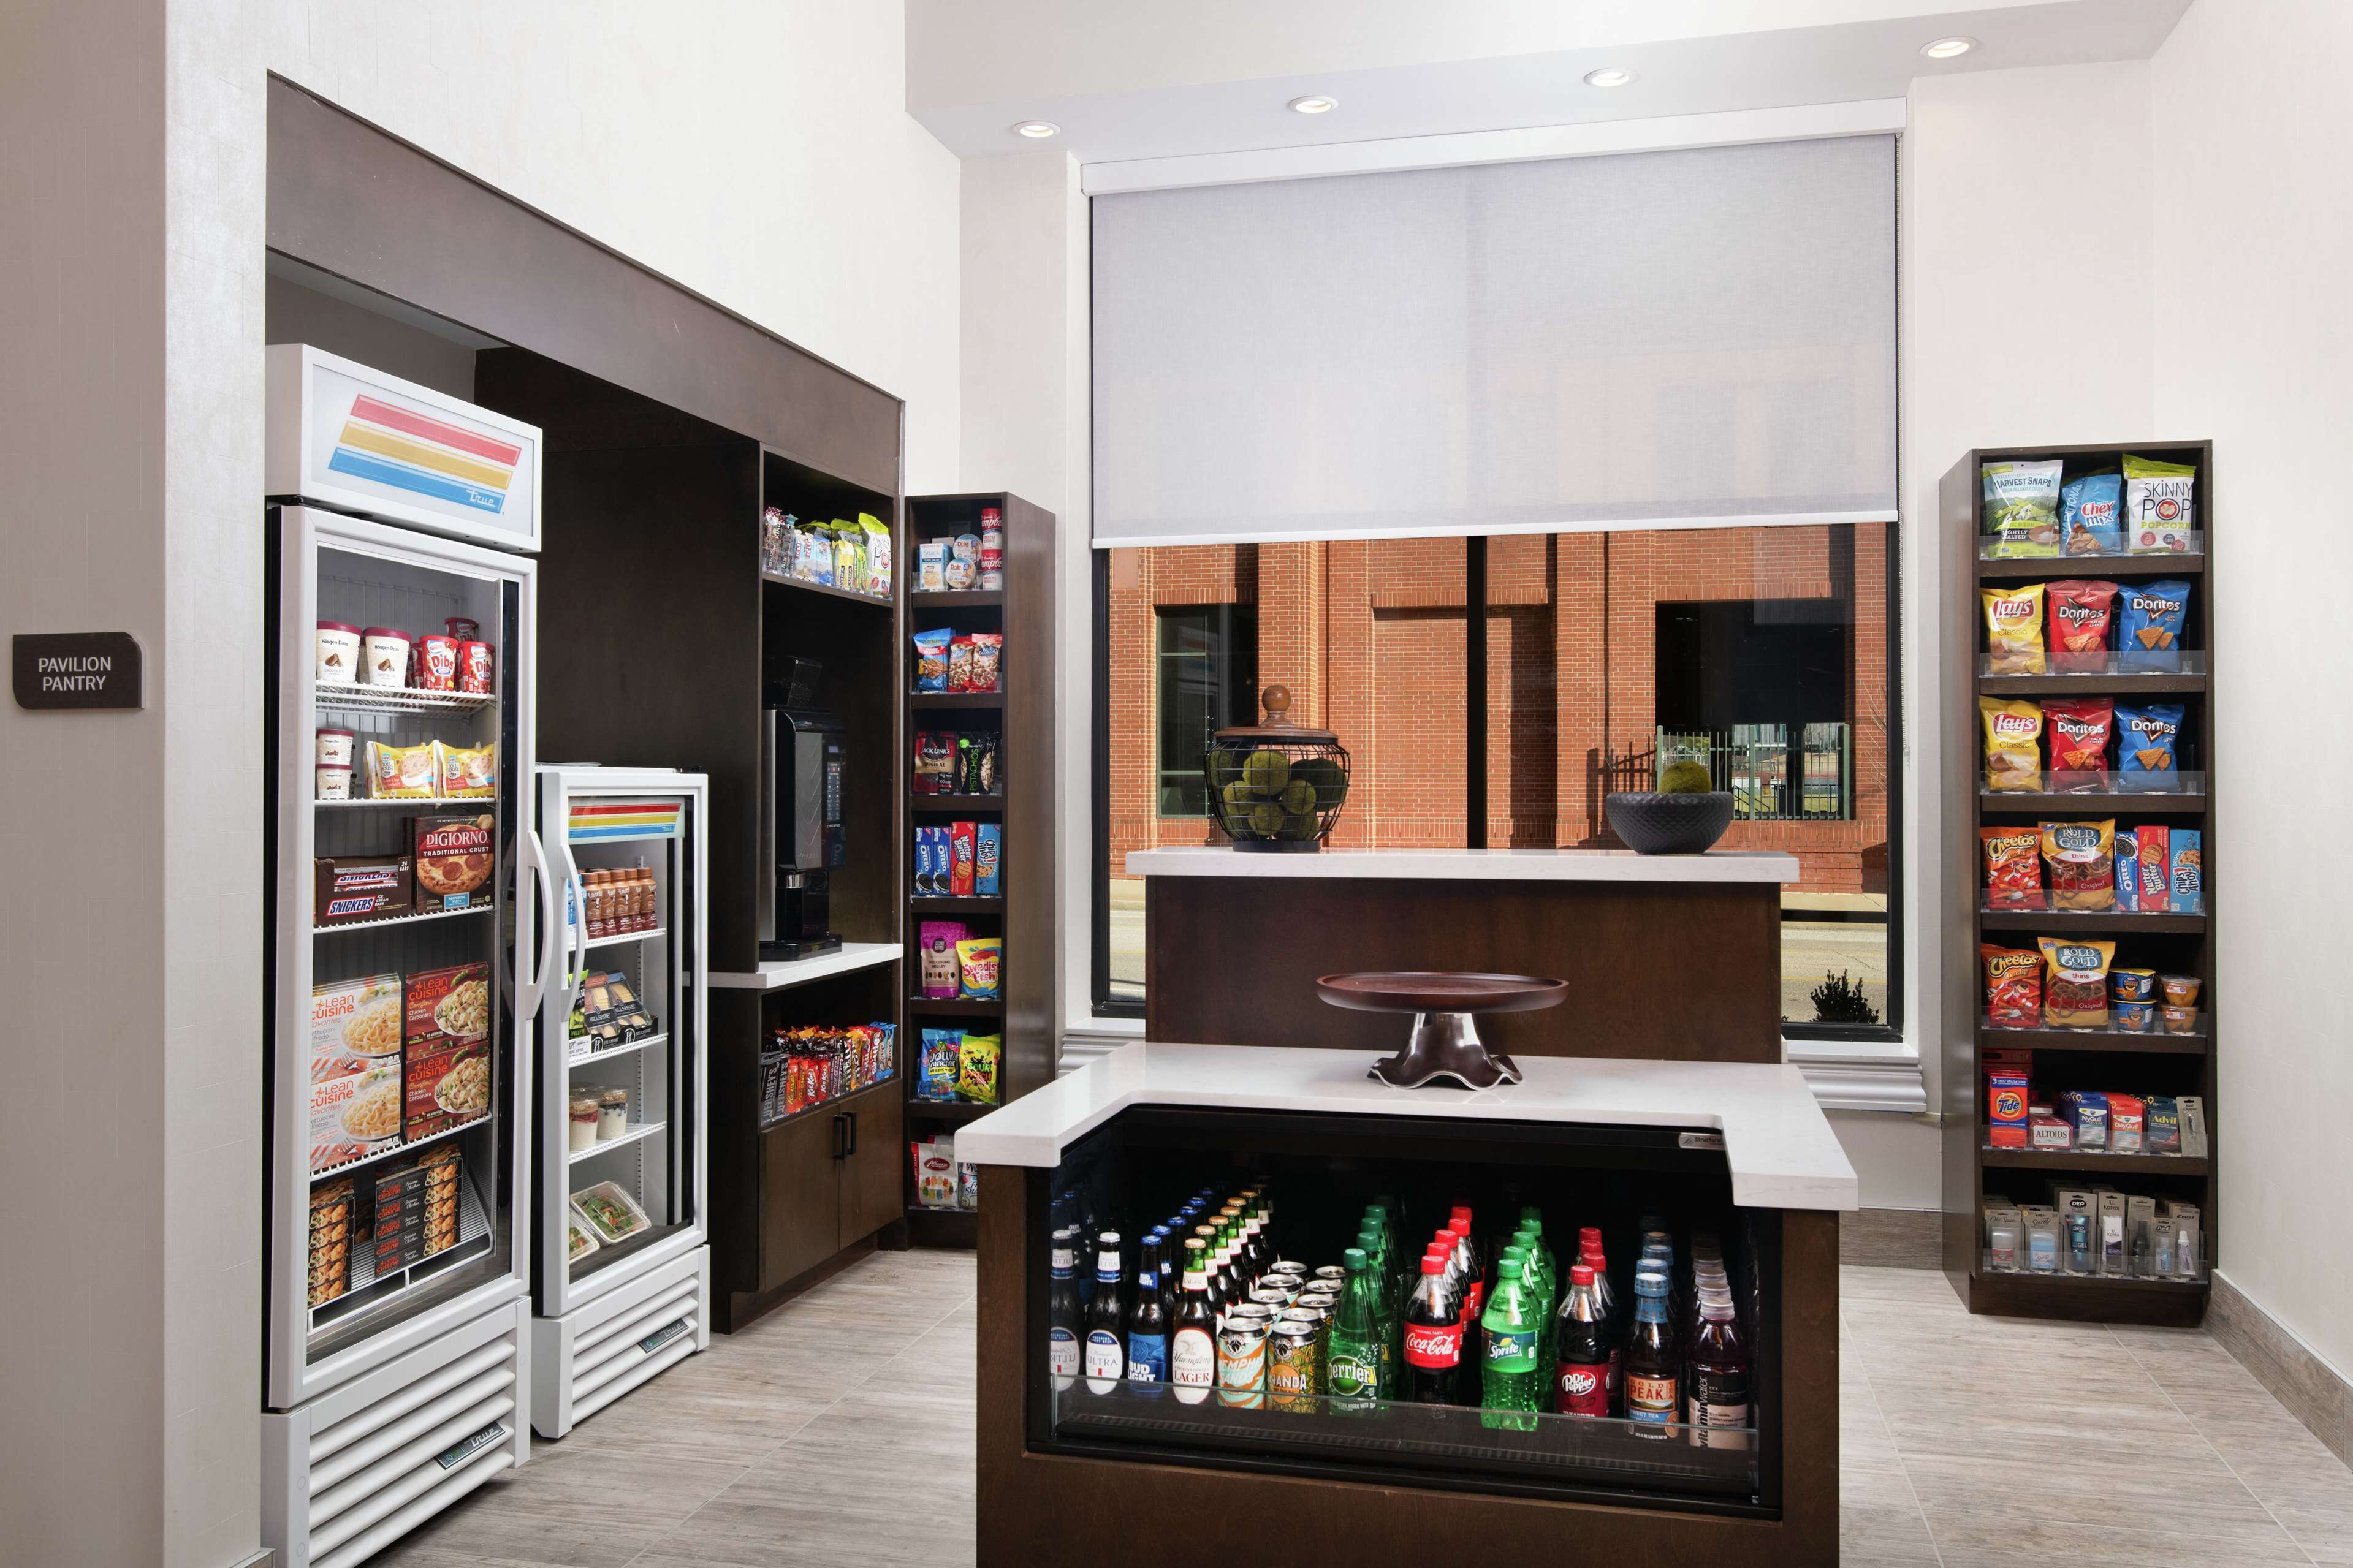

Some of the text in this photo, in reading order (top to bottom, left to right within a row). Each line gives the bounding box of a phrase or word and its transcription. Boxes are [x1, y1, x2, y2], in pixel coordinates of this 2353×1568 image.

[1994, 477, 2052, 488] HARVEST SNAPS
[465, 490, 496, 508] true
[2081, 501, 2115, 517] Chex
[2142, 498, 2192, 521] POP
[2086, 513, 2113, 527] mix
[1996, 599, 2031, 618] Lay's
[2134, 598, 2181, 611] Doritos
[2059, 606, 2104, 619] Doritos
[1998, 628, 2028, 637] Classic
[39, 656, 112, 672] PAVILION
[431, 654, 454, 670] Dibs
[42, 675, 107, 691] PANTRY
[1996, 714, 2036, 733] Lay's
[2058, 722, 2104, 733] Doritos
[2132, 719, 2176, 734] Doritos
[970, 748, 979, 791] PISTACHIOS
[2062, 829, 2094, 838] ROLD
[960, 835, 971, 860] Nutter
[985, 839, 996, 858] Chips
[1987, 835, 2036, 858] Cheetos
[2059, 838, 2096, 847] GOLD
[920, 845, 929, 871] OREO
[938, 845, 946, 871] OREO
[954, 839, 967, 863] Butter
[2121, 860, 2133, 891] OREO
[2142, 866, 2157, 895] Nutter
[2148, 863, 2166, 890] Butter
[2081, 881, 2105, 889] Original
[2176, 872, 2191, 895] Chips
[330, 898, 373, 914] SNICKERS
[2063, 948, 2094, 956] ROLD
[1988, 953, 2041, 977] Cheetos
[2061, 956, 2098, 967] GOLD
[424, 977, 447, 990] Lean
[972, 972, 996, 984] Fish
[325, 994, 354, 1008] Lean
[409, 999, 433, 1009] Comfort
[2078, 1001, 2103, 1010] Original
[312, 1017, 341, 1028] avorites
[409, 1012, 431, 1021] Carbonara
[589, 1012, 610, 1023] HILLSHIRE
[423, 1056, 447, 1069] Lean
[930, 1051, 954, 1062] JOLLY
[966, 1062, 991, 1072] SOUR
[325, 1080, 354, 1096] Lean
[409, 1079, 433, 1090] Comfort
[409, 1088, 426, 1097] Chicken
[409, 1092, 431, 1102] Carbonara
[1998, 1099, 2020, 1113] Tide
[2081, 1115, 2102, 1124] NyQuil
[2152, 1115, 2177, 1124] Advil
[1406, 1333, 1455, 1355] Coca-Cola
[1490, 1344, 1519, 1358] Sprite
[1087, 1355, 1117, 1366] ULTRA
[1173, 1351, 1211, 1366] Yuengling
[1129, 1360, 1150, 1374] BUD
[1128, 1369, 1155, 1382] LIGHT
[1174, 1370, 1209, 1382] LAGER
[1572, 1373, 1586, 1383] Dr
[1562, 1374, 1594, 1393] Pepper
[1630, 1386, 1663, 1400] PEAK
[1698, 1375, 1708, 1448] vitaminwater
[464, 1427, 501, 1448] true
